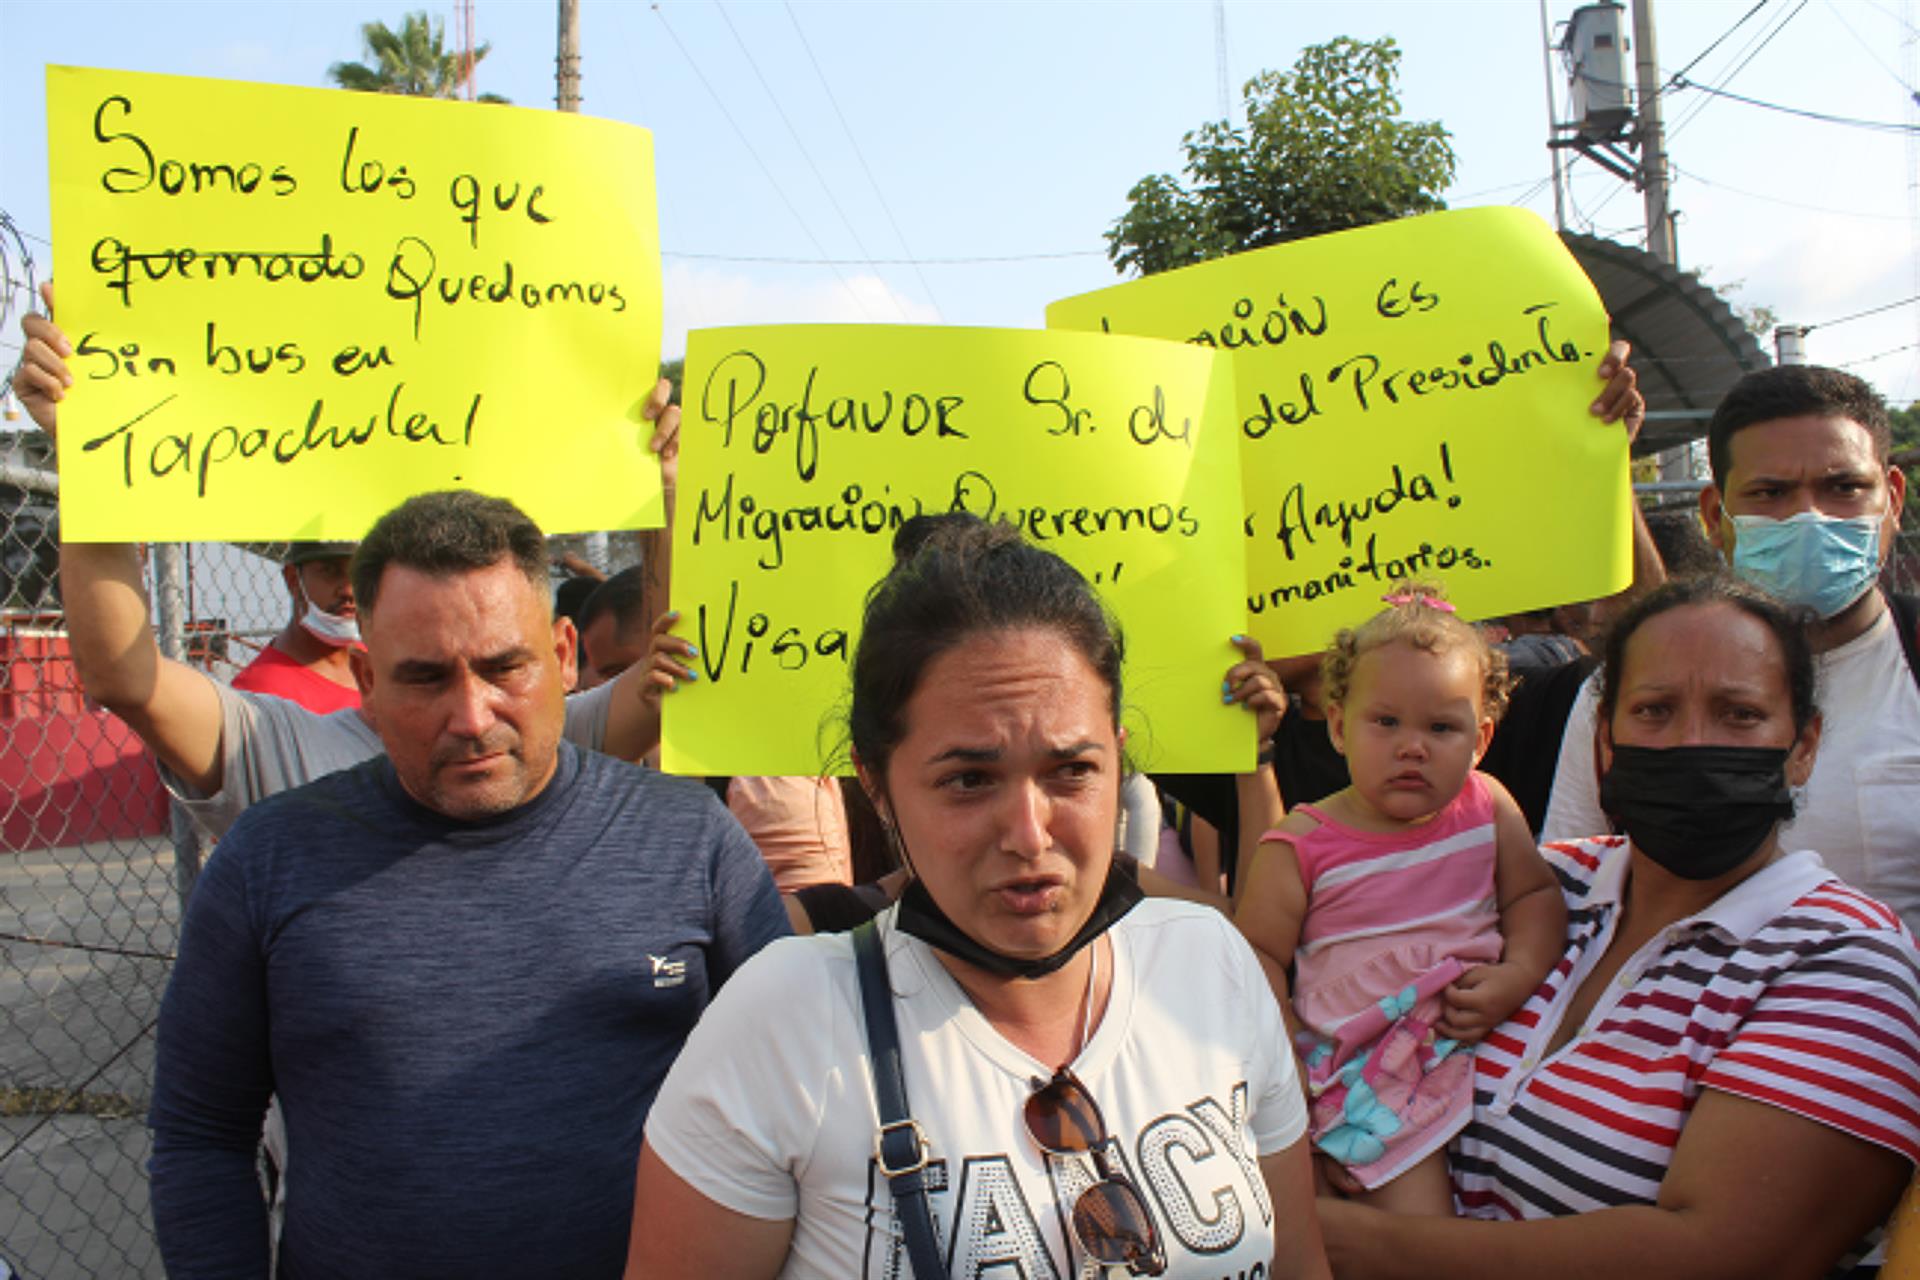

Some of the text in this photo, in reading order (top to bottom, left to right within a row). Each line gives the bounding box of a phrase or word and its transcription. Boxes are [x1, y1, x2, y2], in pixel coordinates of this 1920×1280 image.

[94, 95, 555, 248] Somos los que
[206, 321, 306, 375] bus
[332, 345, 395, 376] en
[1023, 360, 1097, 436] Sr.
[1243, 373, 1323, 439] del
[82, 382, 482, 499] Tapachula!
[1247, 532, 1492, 614] umanitarios.
